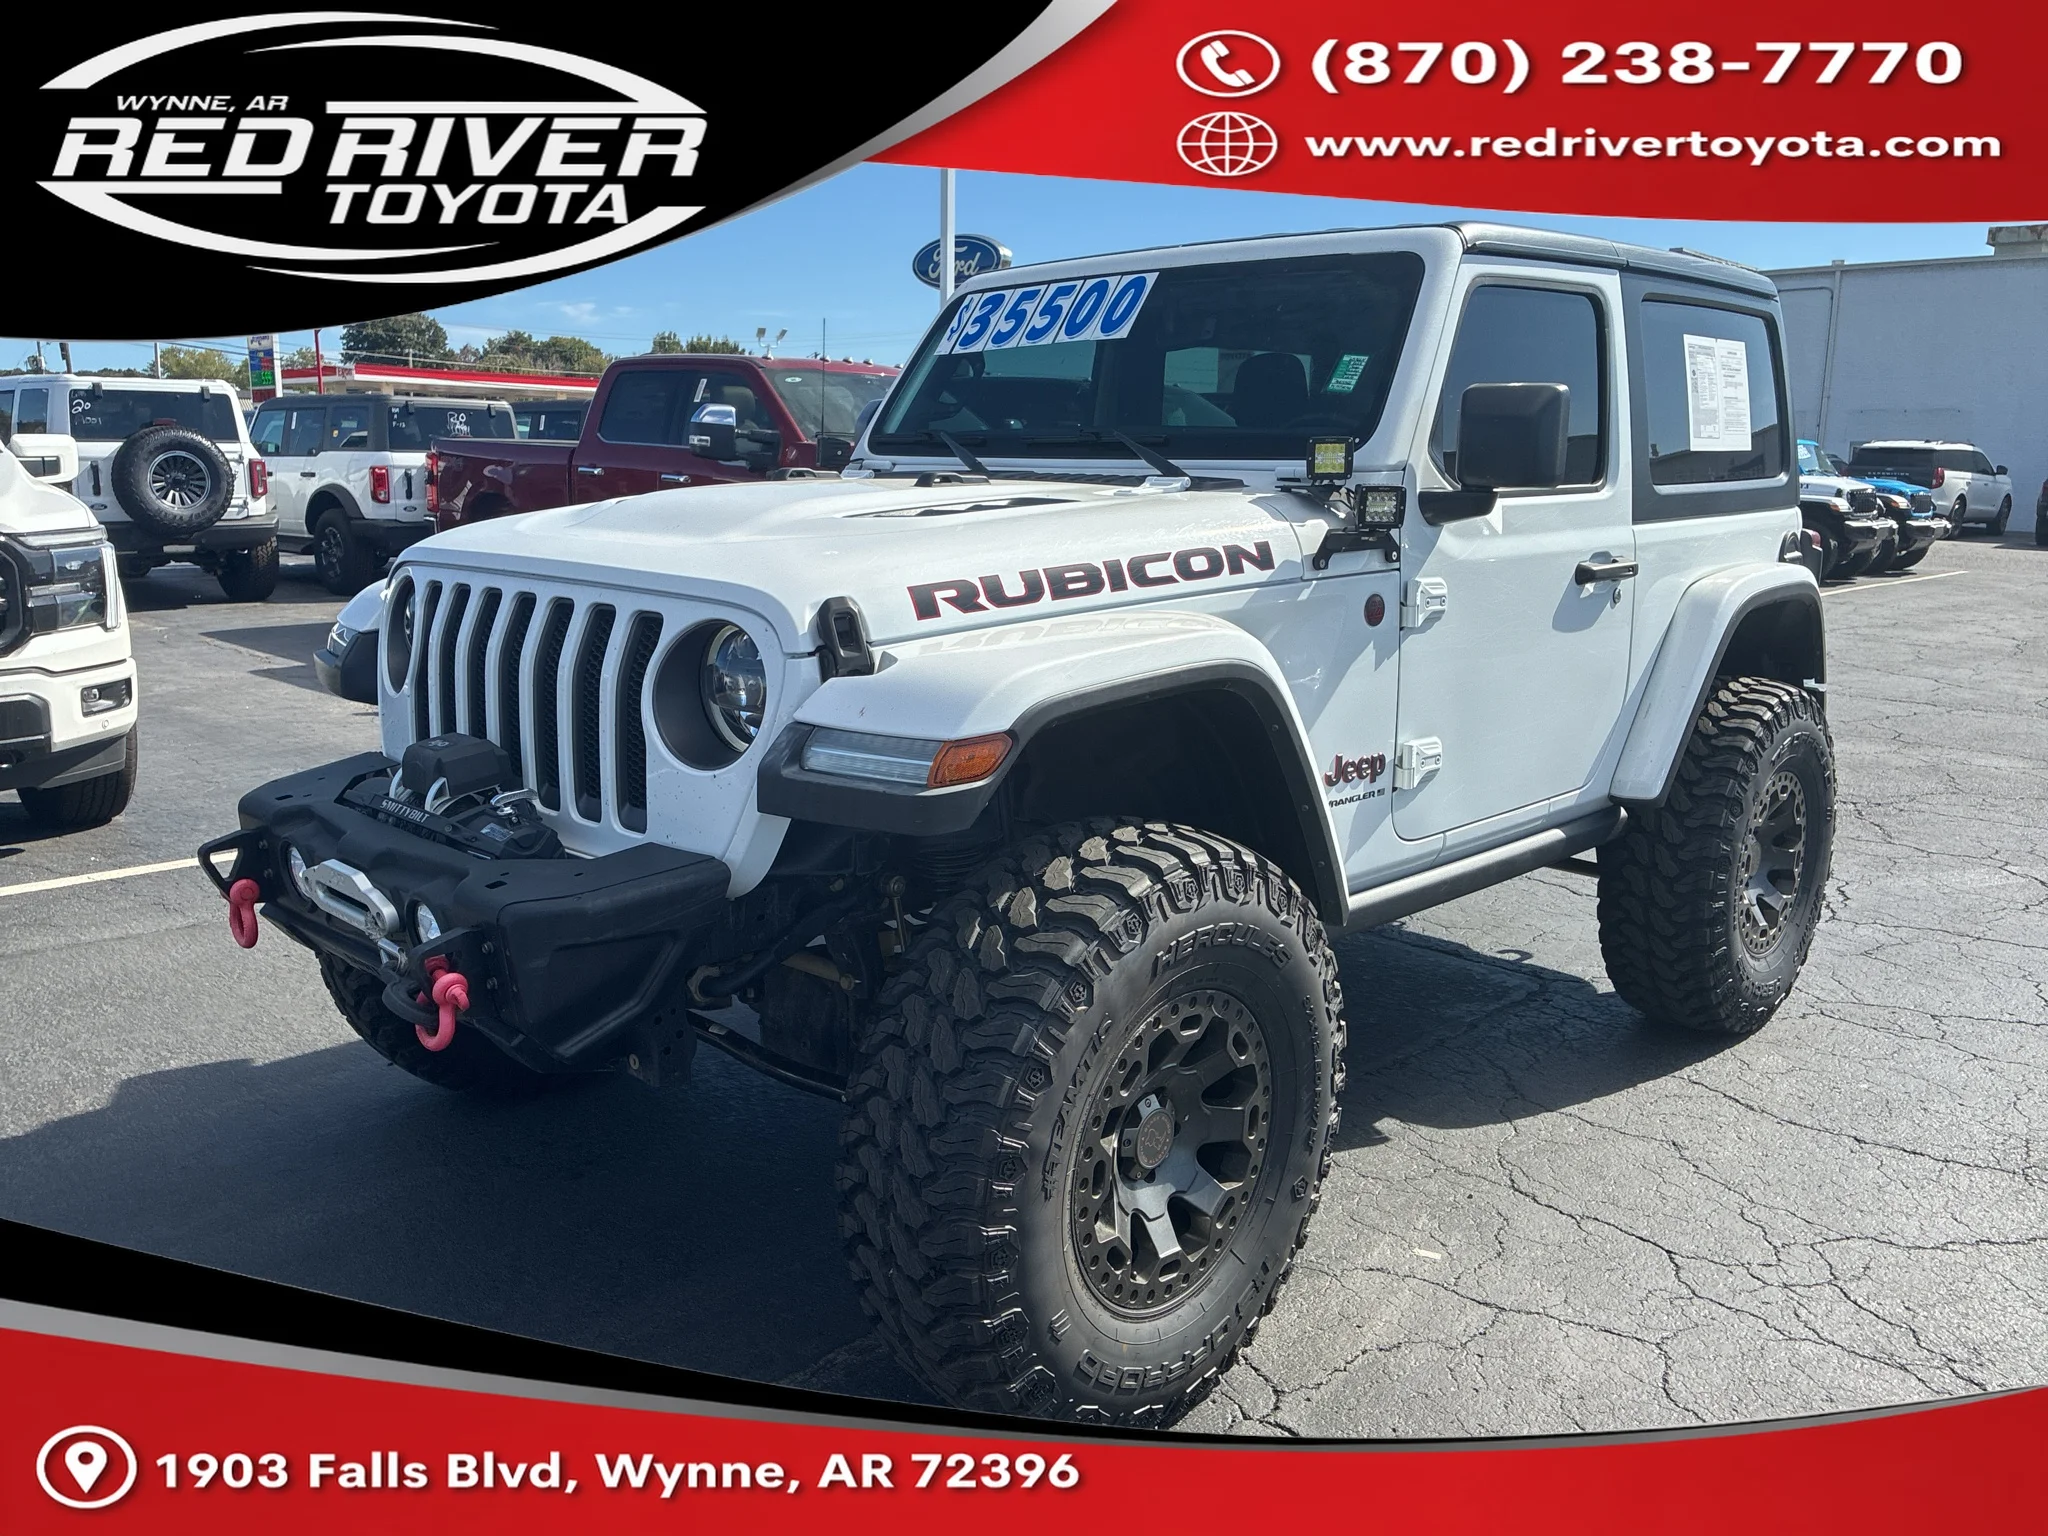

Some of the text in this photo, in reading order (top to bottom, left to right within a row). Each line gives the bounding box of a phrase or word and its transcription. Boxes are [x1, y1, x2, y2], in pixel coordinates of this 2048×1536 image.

[928, 246, 981, 279] Frd
[946, 275, 1148, 348] $35500
[906, 540, 1276, 621] RUBICON
[1324, 752, 1386, 787] Jeep
[380, 799, 430, 823] SMITTYBILT
[1149, 922, 1293, 982] HERCULES
